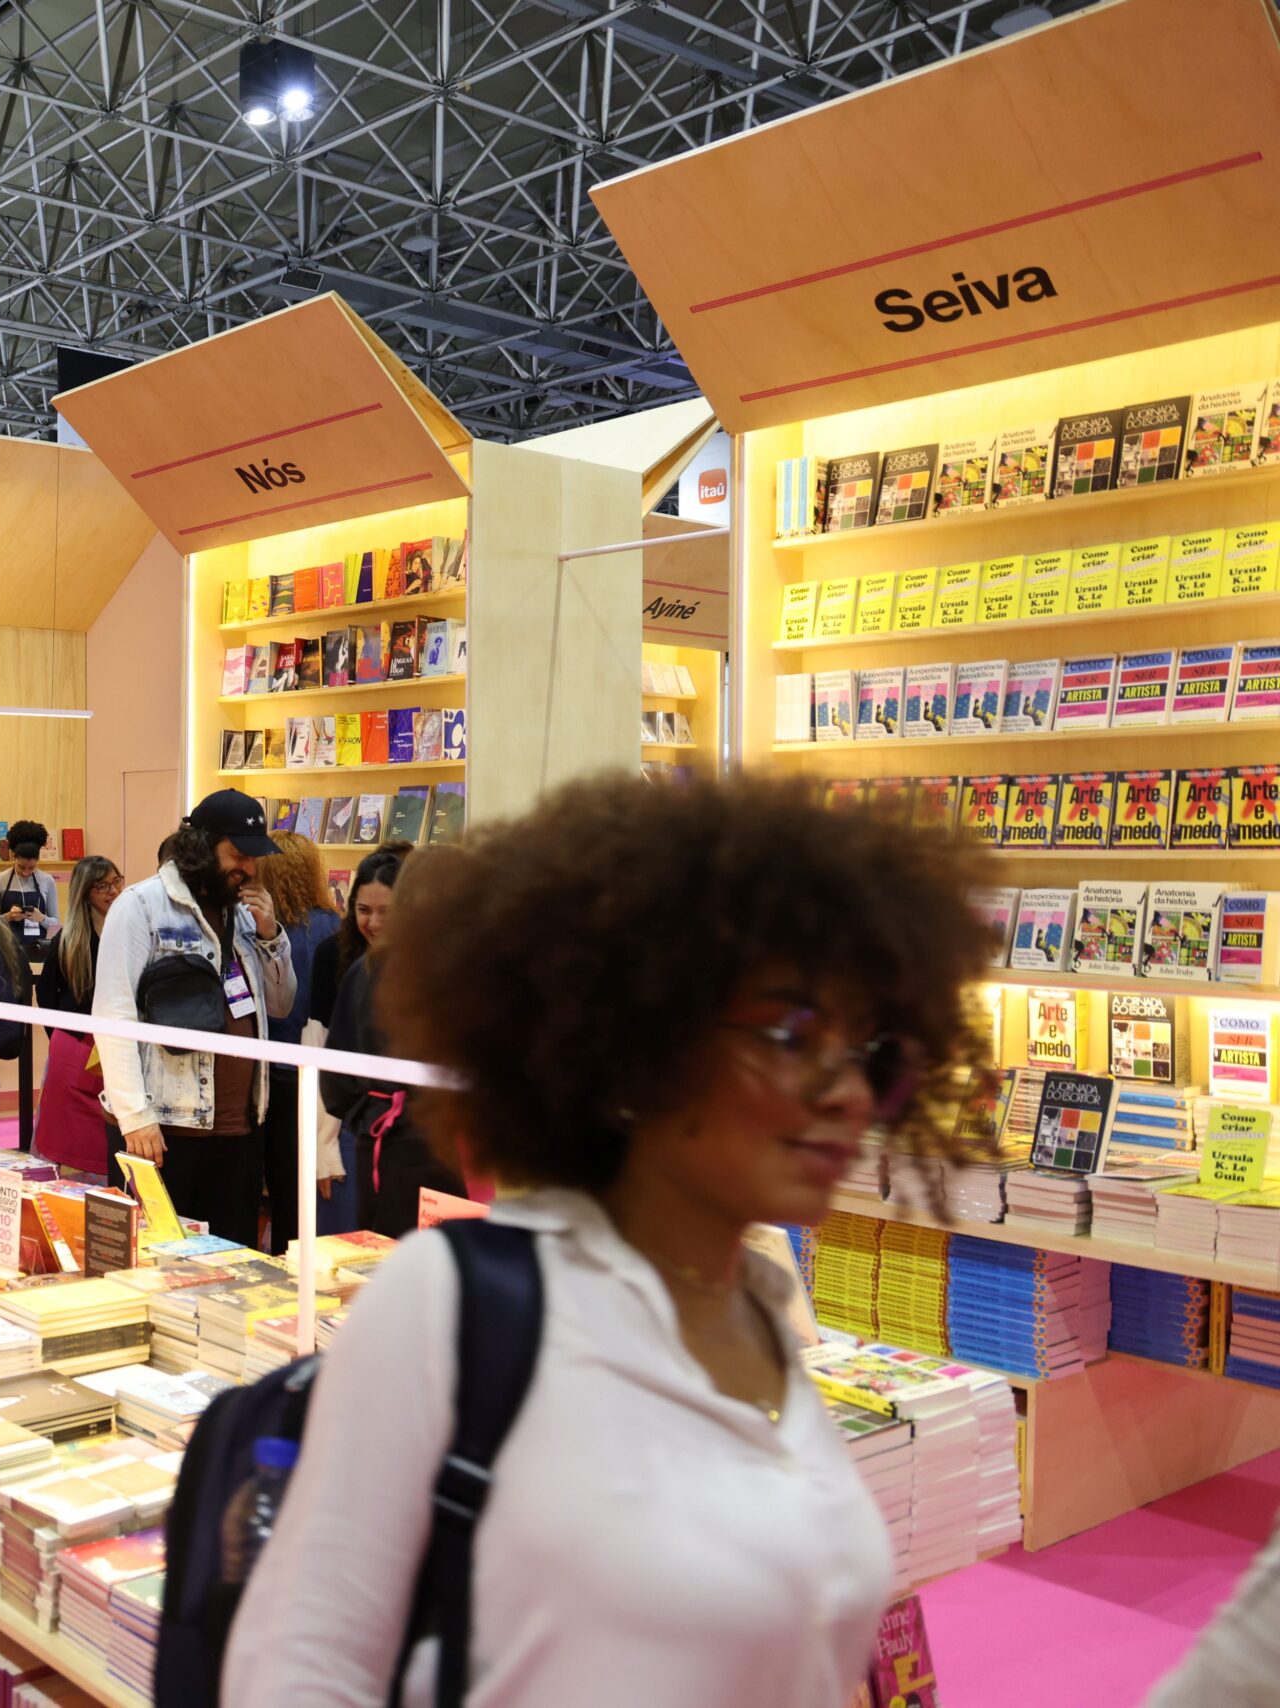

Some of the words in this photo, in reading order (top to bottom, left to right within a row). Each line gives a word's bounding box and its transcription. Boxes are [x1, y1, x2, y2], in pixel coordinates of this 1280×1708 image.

[874, 266, 1058, 333] Seiva
[1200, 391, 1240, 402] Anatomia
[1210, 397, 1241, 408] história
[1129, 411, 1135, 420] A
[1136, 404, 1178, 419] JORNADA
[1127, 418, 1140, 430] DO
[1141, 412, 1179, 427] ESCRITOR
[235, 457, 306, 494] Nós
[700, 482, 725, 499] itaú
[1236, 528, 1268, 539] Como
[1182, 536, 1211, 546] Como
[1237, 538, 1264, 549] criar
[1183, 545, 1209, 555] criar
[1175, 571, 1211, 582] Ursula
[1229, 565, 1267, 576] Ursula
[1233, 575, 1245, 584] K.
[1250, 574, 1261, 582] Le
[1179, 582, 1190, 590] K.
[1232, 584, 1260, 593] Guin
[1178, 590, 1204, 599] Guin
[643, 596, 700, 620] Ayiné
[1128, 655, 1165, 666] COMO
[1187, 650, 1225, 662] COMO
[1124, 685, 1160, 698] ARTISTA
[1183, 681, 1220, 694] ARTISTA
[1070, 787, 1103, 804] Arte
[1125, 783, 1160, 803] Arte
[1241, 781, 1278, 800] Arte
[969, 789, 998, 805] Arte
[978, 808, 985, 822] e
[1080, 807, 1088, 822] e
[1137, 806, 1145, 821] e
[1254, 804, 1264, 819] e
[1063, 823, 1102, 840] medo
[1121, 822, 1161, 840] medo
[1238, 820, 1280, 840] medo
[1084, 886, 1121, 895] Anatomia
[1156, 889, 1195, 897] Anatomia
[1094, 895, 1122, 903] história
[1166, 897, 1196, 905] história
[1228, 901, 1259, 909] COMO
[1227, 934, 1257, 946] ARTISTA
[1112, 996, 1121, 1005] A
[1121, 996, 1164, 1008] JORNADA
[1038, 1003, 1068, 1021] Arte
[1112, 1004, 1128, 1015] DO
[1129, 1006, 1166, 1018] ESCRITOR
[1220, 1017, 1259, 1029] COMO
[1049, 1024, 1056, 1038] e
[1035, 1041, 1071, 1057] medo
[1220, 1050, 1260, 1066] ARTISTA
[1048, 1081, 1055, 1091] A
[1056, 1081, 1098, 1093] JORNADA
[1046, 1090, 1061, 1100] DO
[1062, 1091, 1100, 1105] ESCRITOR
[1221, 1112, 1256, 1123] Como
[1221, 1123, 1252, 1132] criar
[1212, 1151, 1254, 1163] Ursula
[1215, 1161, 1228, 1171] K.
[1233, 1163, 1246, 1172] Le
[1214, 1172, 1245, 1183] Guin
[880, 1630, 914, 1659] Pauly
